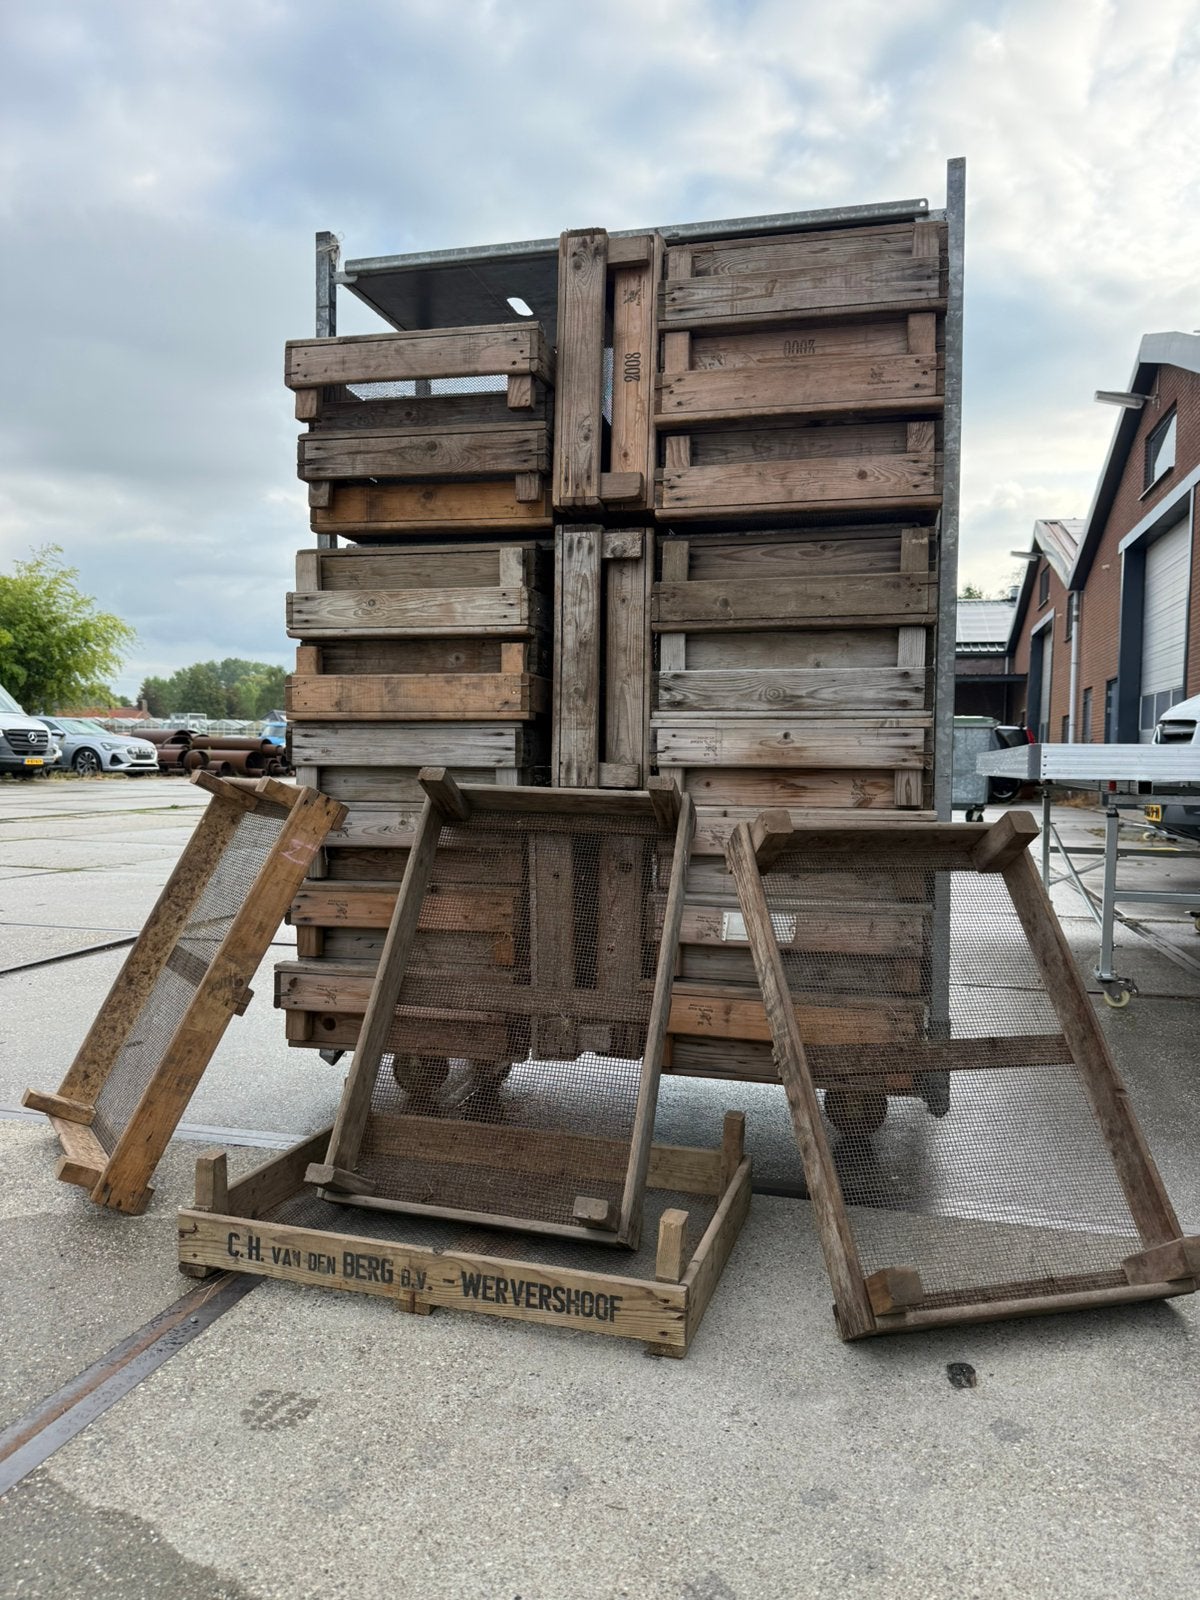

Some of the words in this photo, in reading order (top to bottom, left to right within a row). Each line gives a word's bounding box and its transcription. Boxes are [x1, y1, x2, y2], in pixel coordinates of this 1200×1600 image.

[624, 352, 641, 382] 2008
[227, 1232, 265, 1263] C.H.
[271, 1245, 301, 1268] VAN
[307, 1252, 337, 1275] DEN
[342, 1251, 394, 1284] BERG
[460, 1270, 623, 1322] WERVERSHOOF
